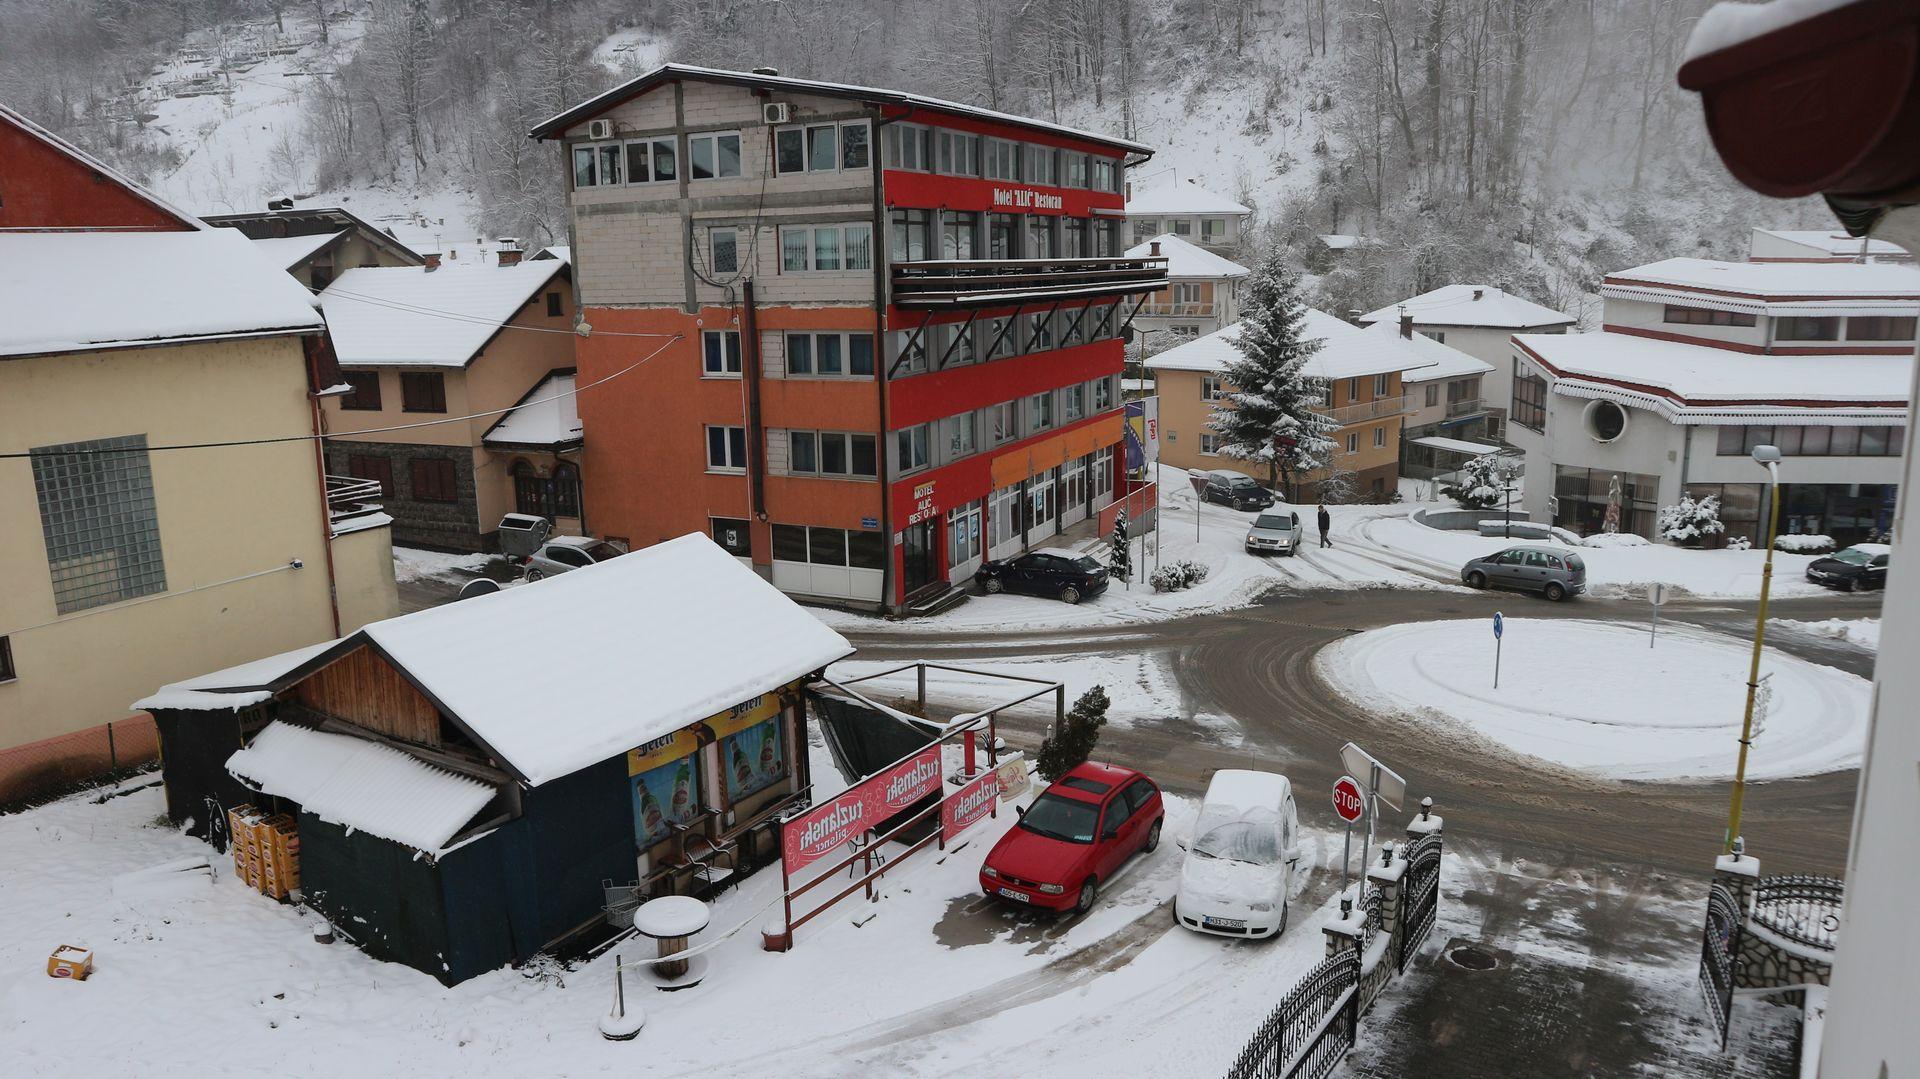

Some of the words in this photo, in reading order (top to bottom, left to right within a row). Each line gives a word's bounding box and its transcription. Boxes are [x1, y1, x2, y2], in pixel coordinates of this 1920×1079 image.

[994, 188, 1012, 206] Motel
[1034, 192, 1062, 209] Restoran
[914, 486, 934, 500] MOTEL
[1334, 788, 1361, 812] STOP
